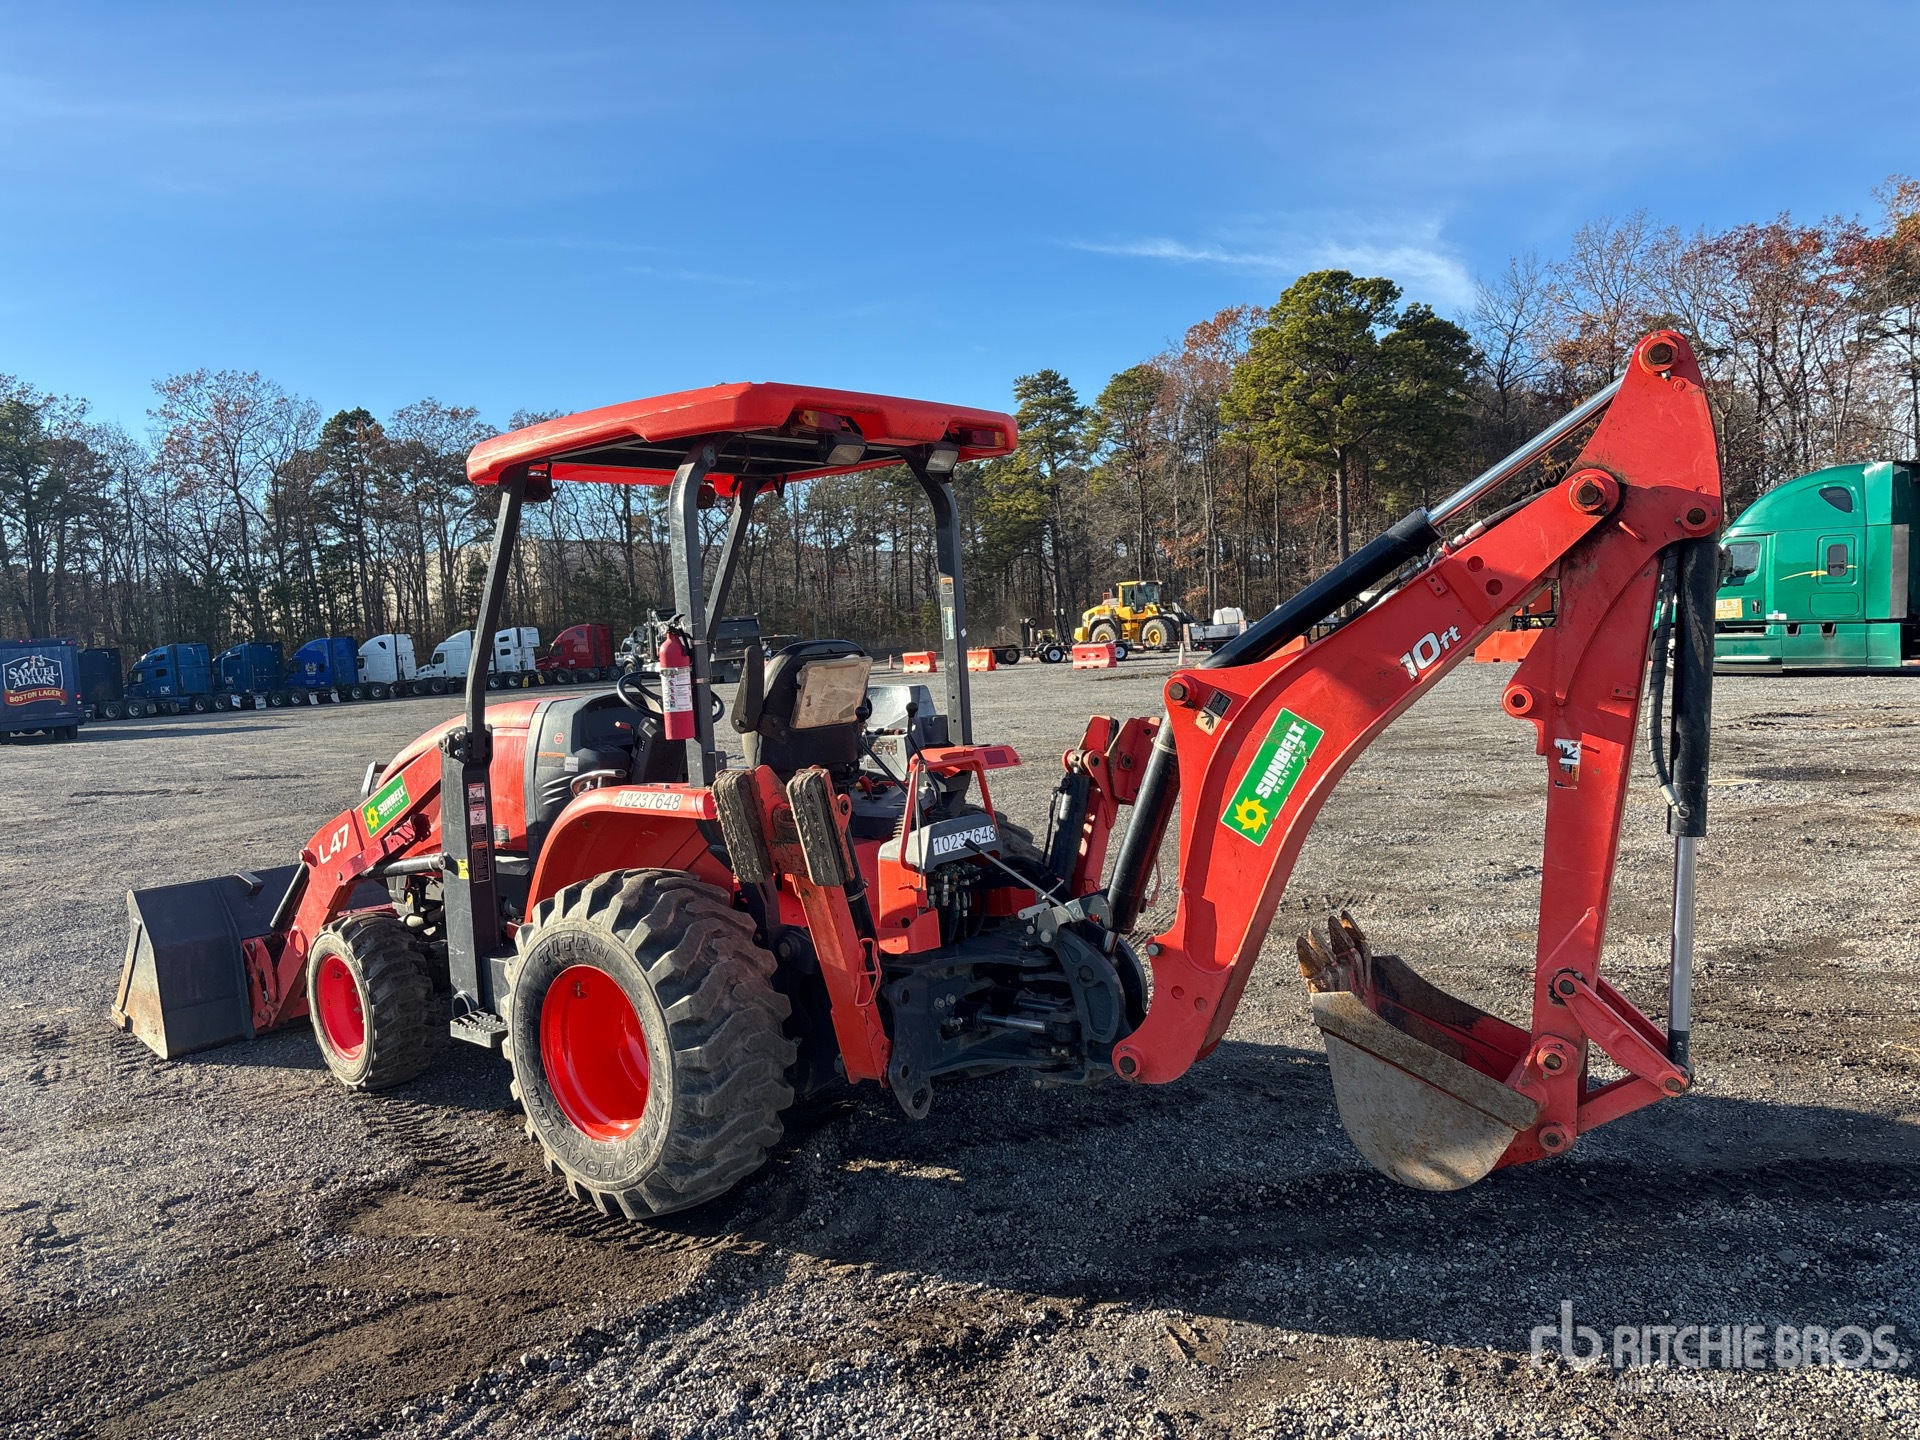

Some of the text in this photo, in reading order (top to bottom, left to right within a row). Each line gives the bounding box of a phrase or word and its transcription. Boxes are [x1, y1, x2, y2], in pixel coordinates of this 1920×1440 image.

[8, 665, 59, 680] SAMUEL
[13, 675, 56, 689] ADAMS
[9, 689, 61, 703] BOSTON LAGER
[1255, 721, 1306, 799] SUNBELT
[1273, 740, 1306, 794] RENTALS
[377, 784, 406, 816] SUNBELT
[617, 791, 682, 811] 10237648
[934, 825, 996, 853] 10237648
[538, 935, 610, 966] TITAN
